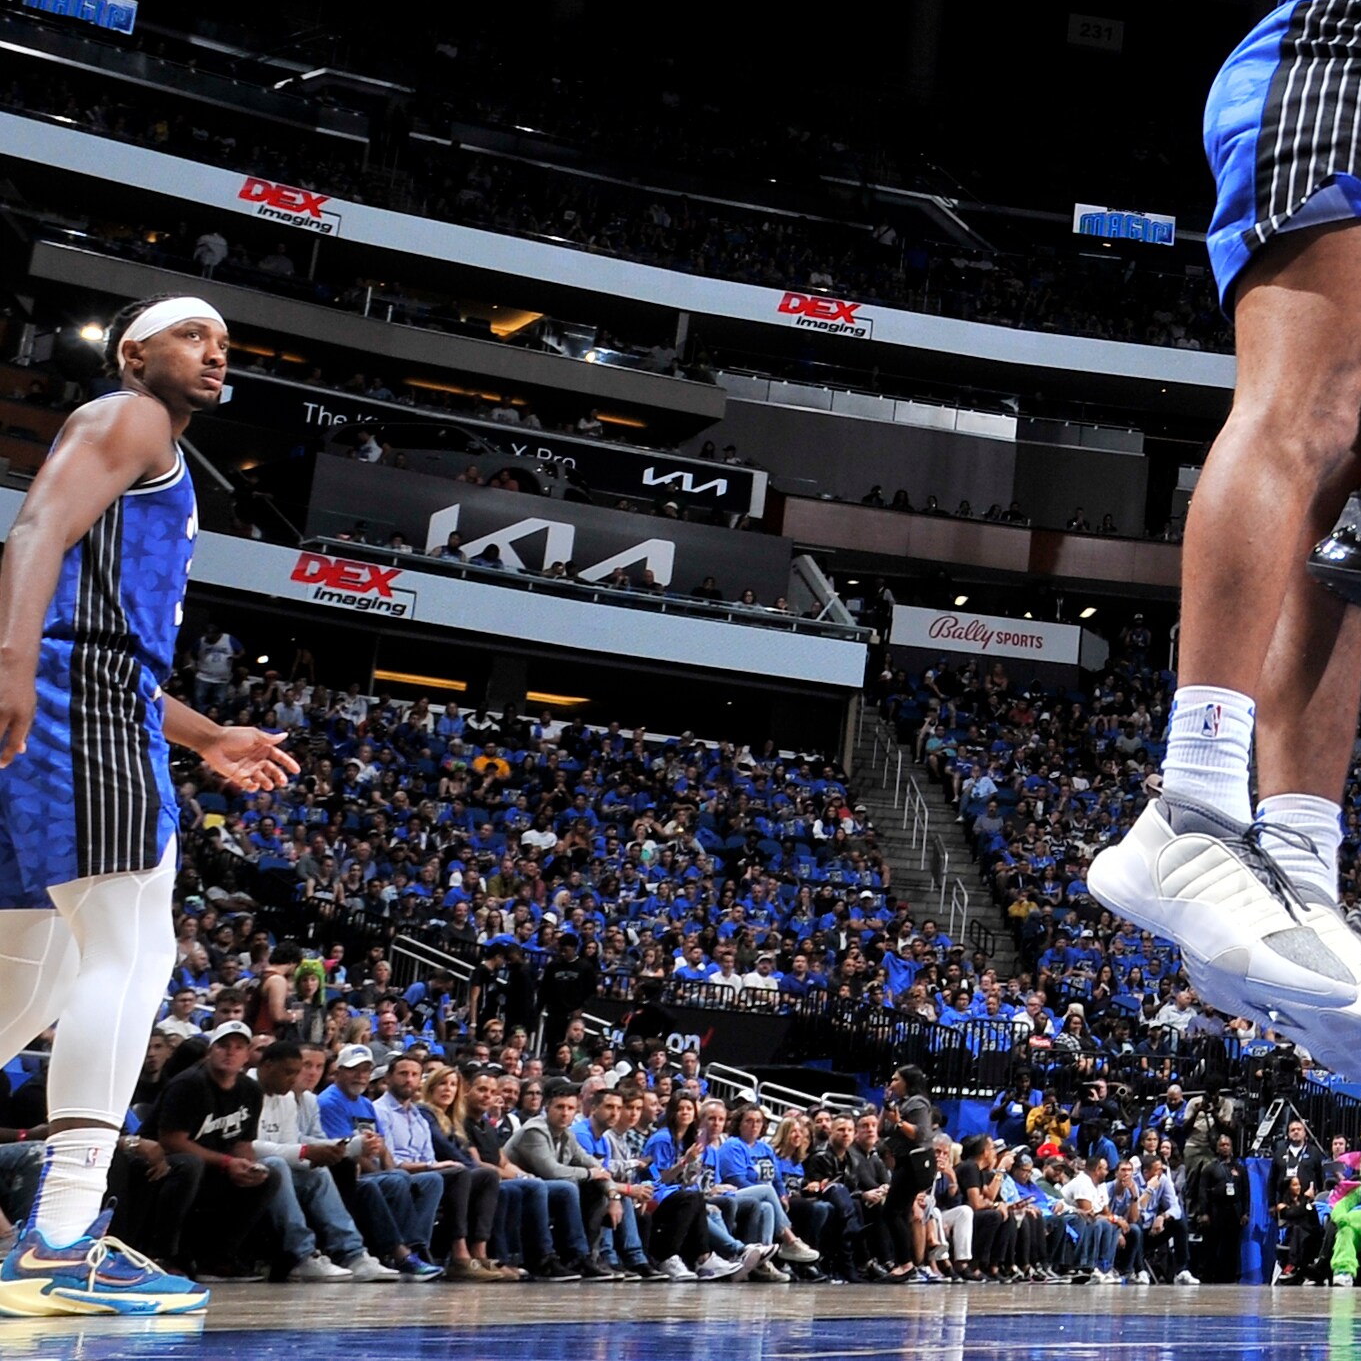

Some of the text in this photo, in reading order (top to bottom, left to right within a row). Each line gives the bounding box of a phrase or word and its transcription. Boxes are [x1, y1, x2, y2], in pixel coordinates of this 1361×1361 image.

[1080, 22, 1113, 41] 231
[238, 176, 331, 218] DEX
[257, 204, 333, 233] imaging
[777, 292, 862, 324] DEX
[796, 316, 867, 338] imaging
[303, 402, 347, 427] The
[290, 553, 403, 597] DEX
[312, 587, 407, 616] imaging
[928, 615, 1043, 650] Bally SPORTS
